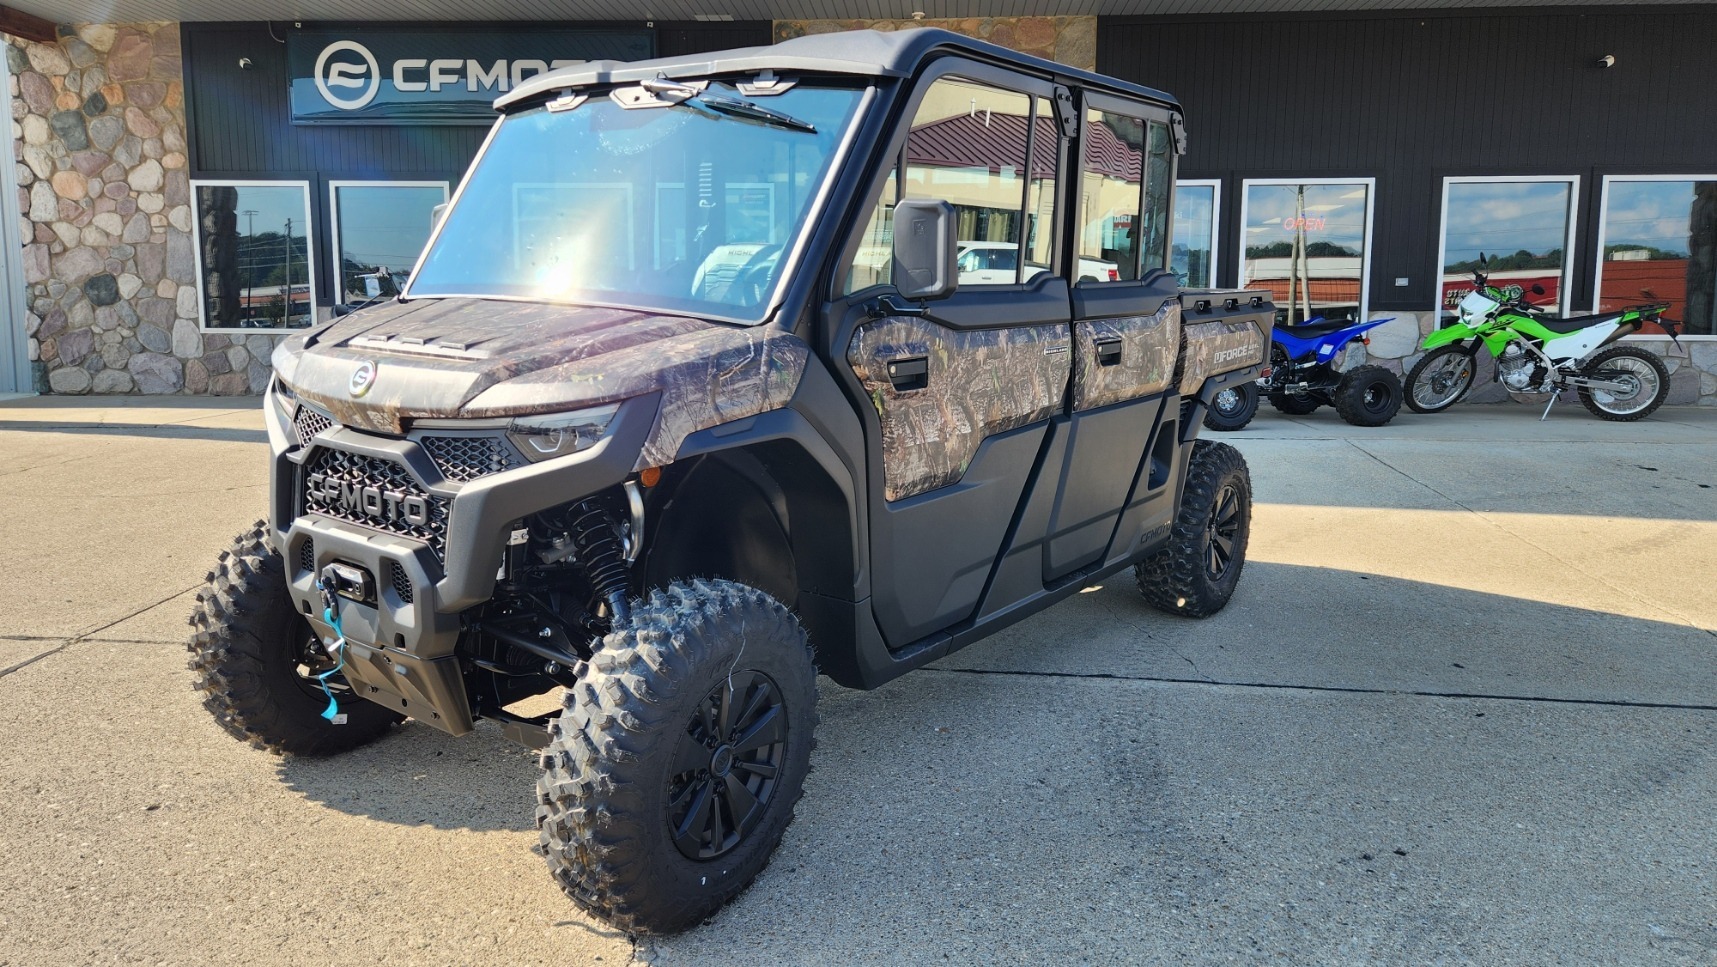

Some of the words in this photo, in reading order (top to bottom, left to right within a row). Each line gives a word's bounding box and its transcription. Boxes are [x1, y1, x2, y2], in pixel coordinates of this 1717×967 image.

[393, 59, 586, 92] CFMO
[1284, 217, 1325, 231] OPEN
[309, 473, 428, 526] CFMOTO
